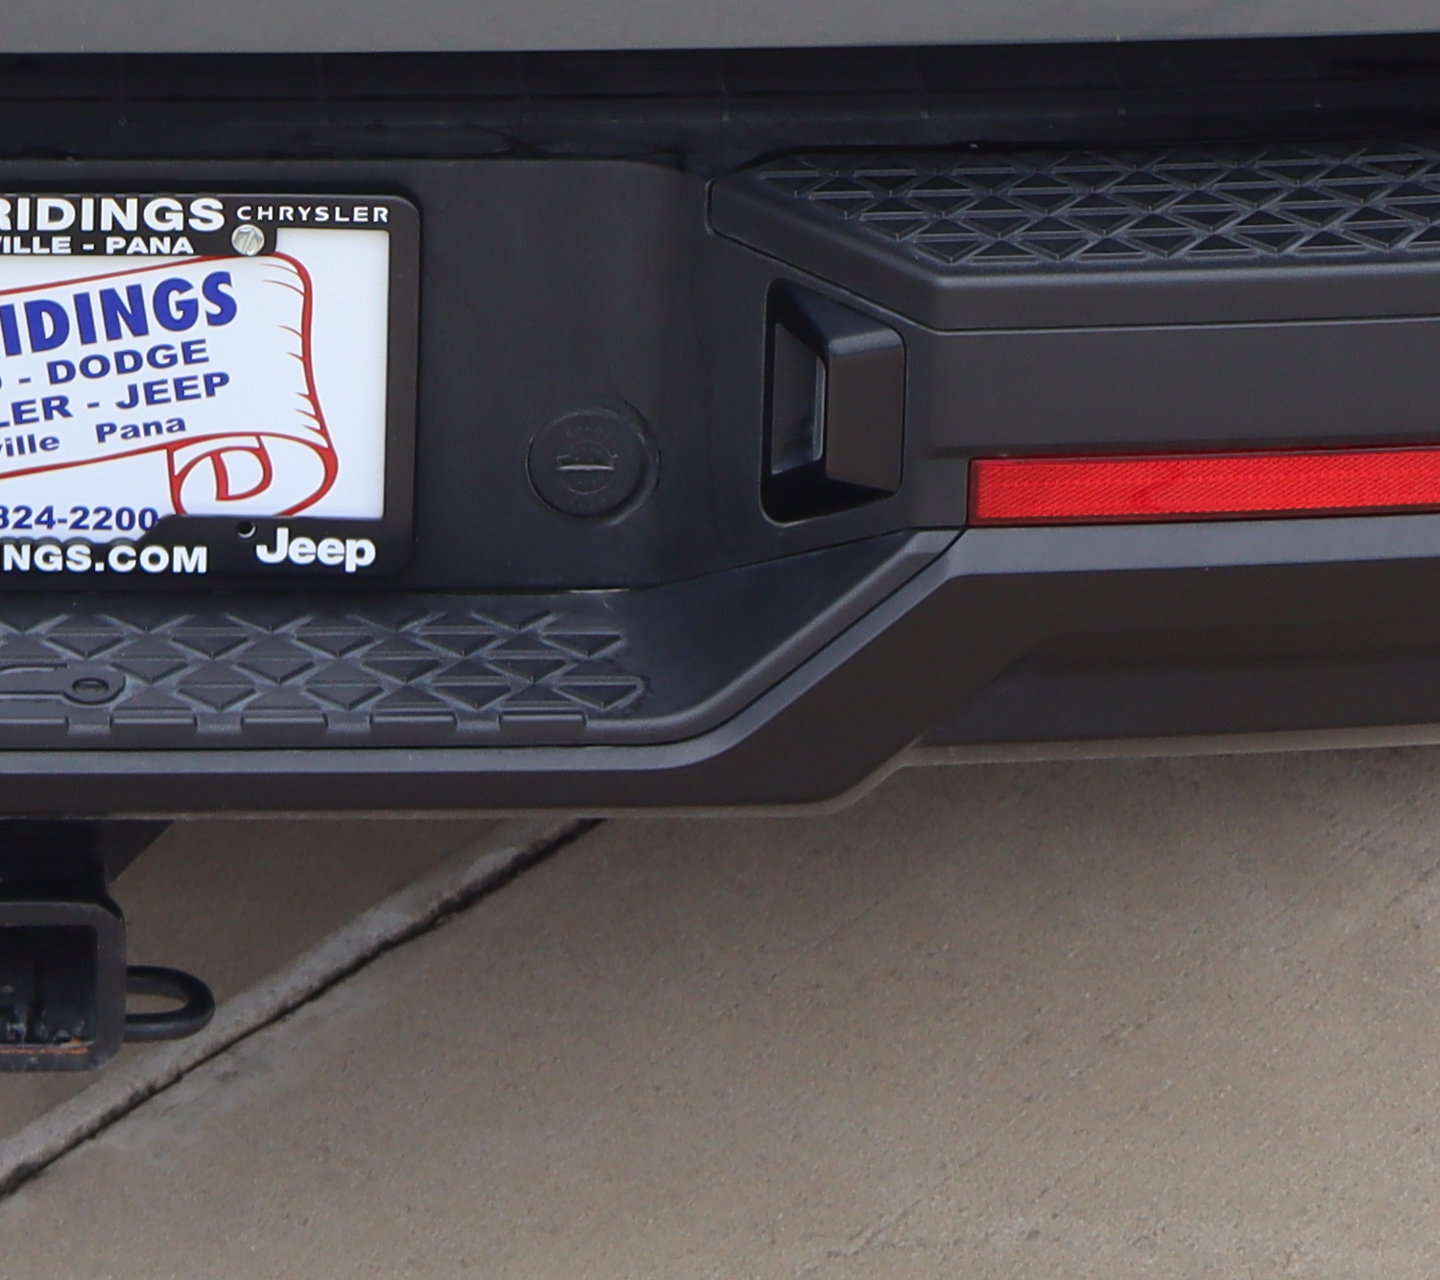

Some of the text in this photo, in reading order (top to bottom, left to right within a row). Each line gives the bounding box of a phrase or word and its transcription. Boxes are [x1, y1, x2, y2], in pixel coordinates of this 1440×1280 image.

[236, 205, 390, 224] CHRYSLER
[105, 235, 195, 257] PANA
[46, 338, 211, 386] DODGE
[115, 370, 232, 411] JEEP
[94, 416, 188, 444] Pana
[256, 527, 378, 574] Jeep
